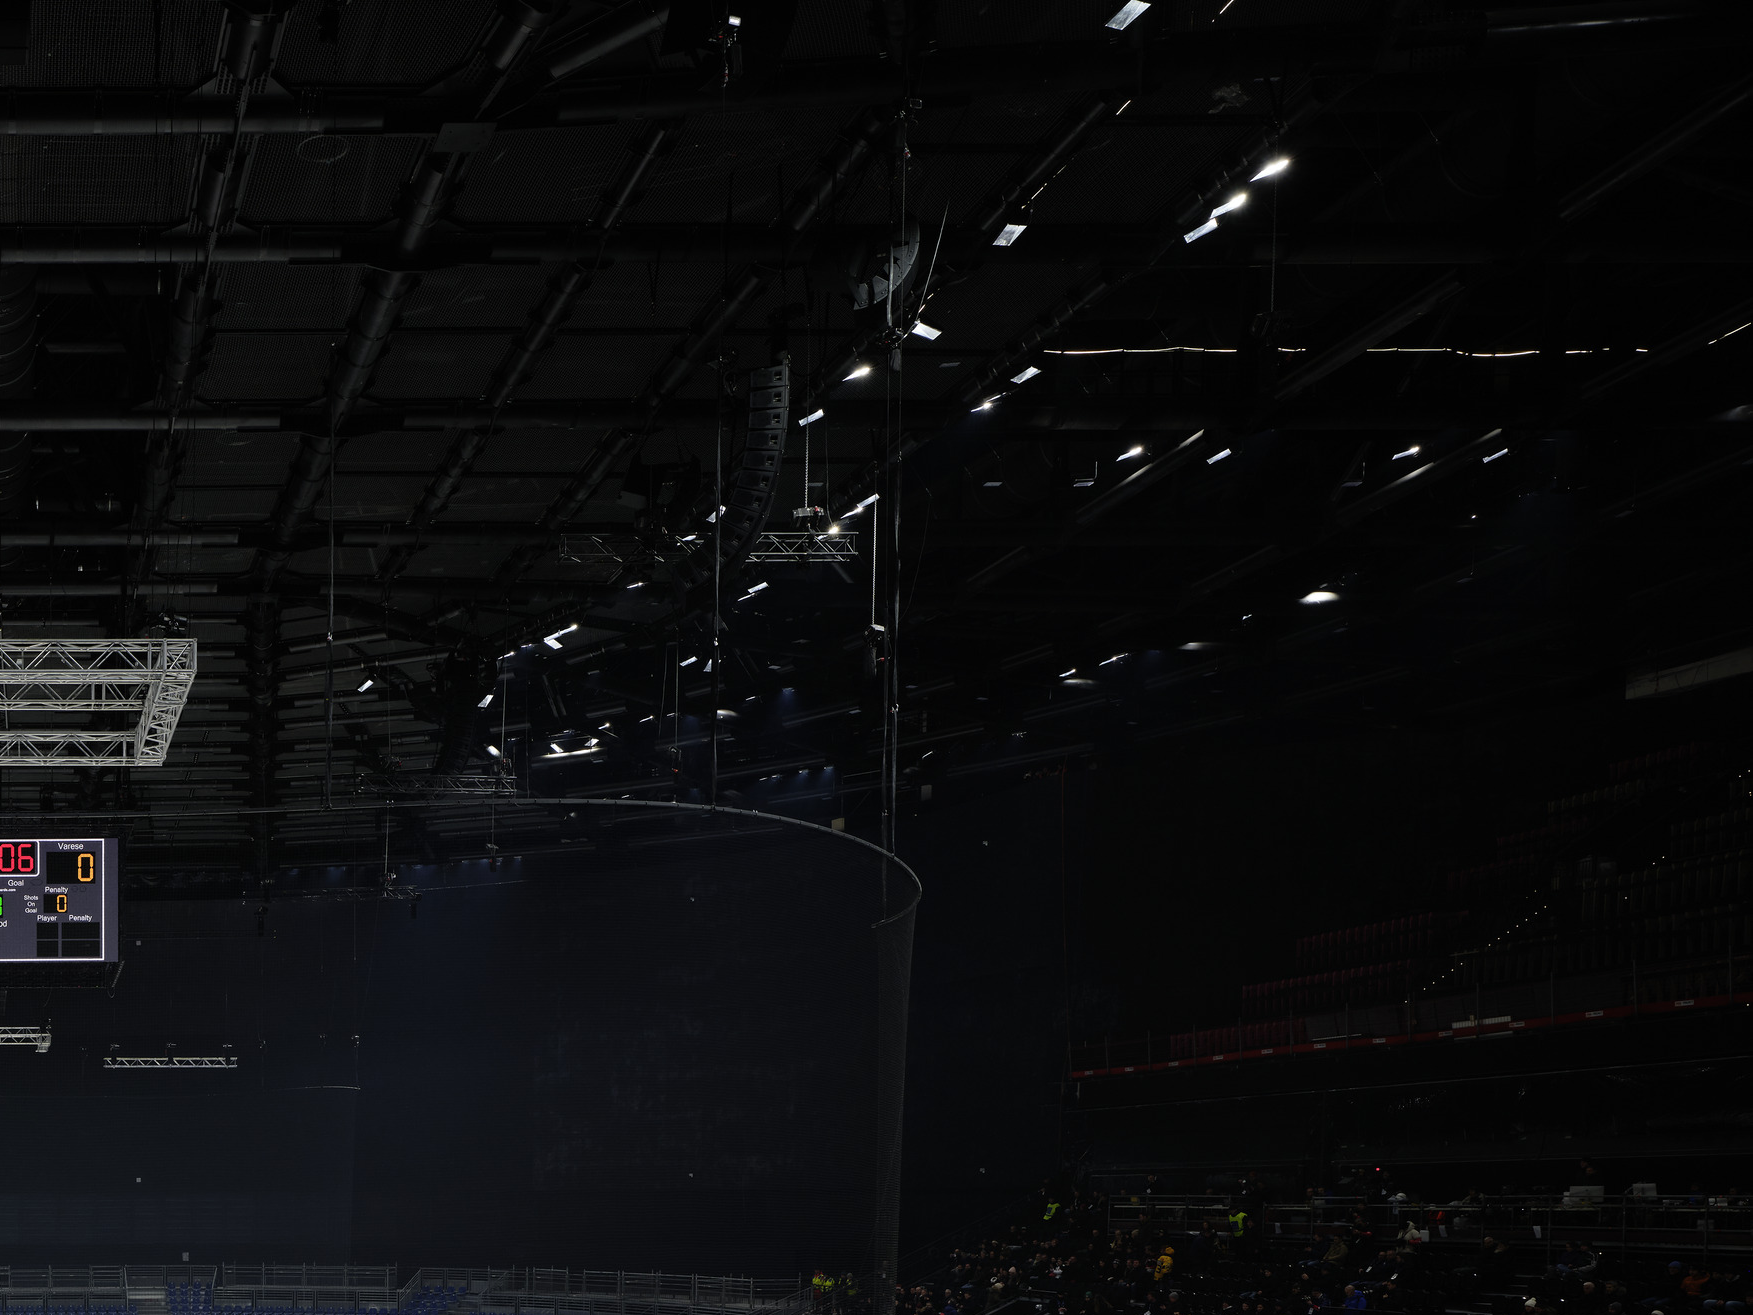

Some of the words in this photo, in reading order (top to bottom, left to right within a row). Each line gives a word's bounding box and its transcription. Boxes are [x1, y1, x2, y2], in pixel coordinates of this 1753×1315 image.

[58, 842, 84, 850] Varese
[77, 853, 94, 882] 0
[8, 879, 24, 887] Goal
[45, 886, 68, 894] Penalty
[57, 895, 67, 913] 0
[69, 914, 92, 922] Penalty
